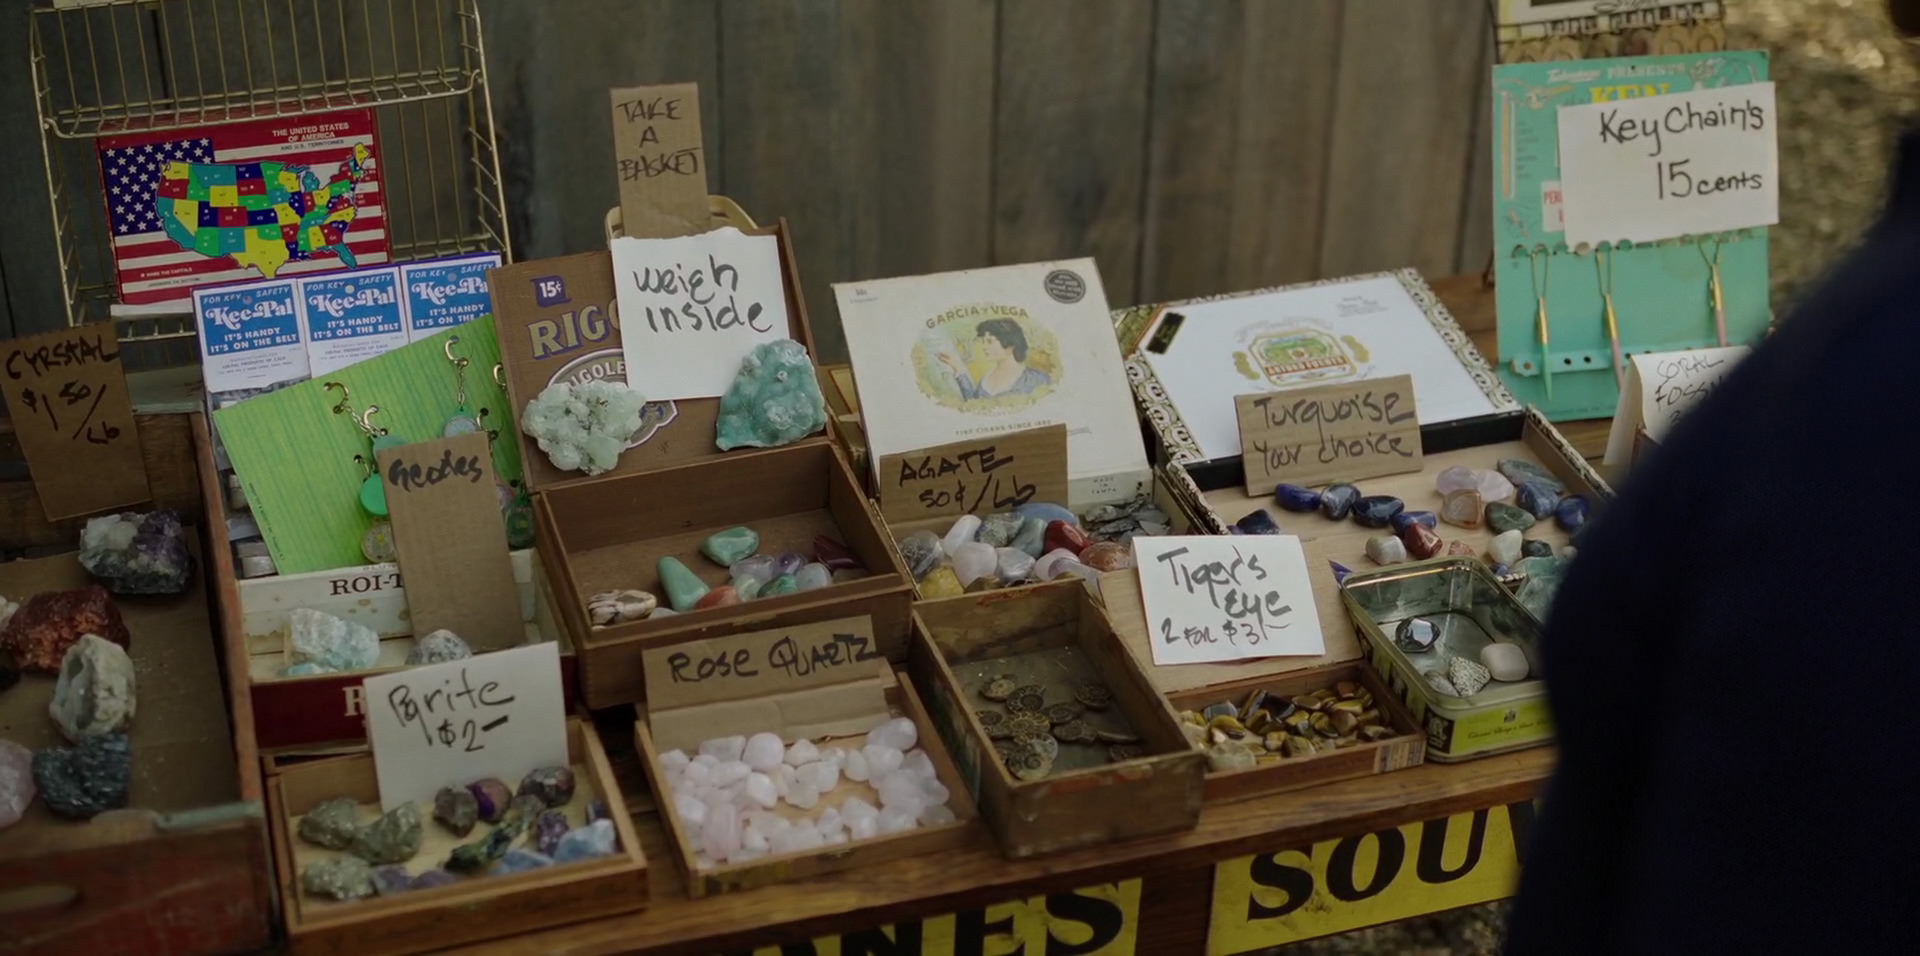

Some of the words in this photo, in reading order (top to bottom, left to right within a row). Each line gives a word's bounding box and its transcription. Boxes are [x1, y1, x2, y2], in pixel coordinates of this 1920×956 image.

[616, 97, 682, 123] TAKE
[272, 128, 288, 137] THE
[289, 125, 318, 136] UNITED
[319, 122, 350, 132] STATES
[288, 135, 300, 143] OF
[301, 132, 336, 142] AMERICA
[639, 126, 660, 148] A
[619, 147, 701, 181] BASKET
[1657, 159, 1693, 201] 15
[1697, 172, 1763, 195] cents
[327, 281, 345, 289] KEY
[359, 274, 392, 285] SAFETY
[410, 271, 426, 279] FOR
[461, 263, 494, 274] SAFETY
[632, 253, 738, 305] weigh
[203, 296, 220, 304] FOR
[224, 293, 242, 302] KEY
[256, 286, 290, 298] SAFETY
[539, 280, 562, 298] 15¢
[327, 319, 345, 328] IT'S
[348, 315, 383, 326] HANDY
[416, 318, 434, 327] IT'S
[438, 316, 453, 324] ON
[429, 308, 447, 316] IT'S
[450, 304, 484, 314] HANDY
[646, 295, 773, 333] inside
[925, 306, 980, 329] GARCIA
[990, 305, 1029, 319] VEGA
[224, 332, 242, 342] IT'S
[245, 327, 280, 339] HANDY
[314, 330, 332, 339] IT'S
[336, 328, 352, 336] ON
[356, 325, 374, 334] THE
[378, 322, 399, 332] BELT
[210, 344, 229, 353] IT'S
[233, 341, 249, 350] ON
[253, 338, 272, 347] THE
[276, 334, 297, 343] BELT
[6, 335, 120, 379] CYRSTAL
[1254, 390, 1415, 447] Turquoise
[1318, 433, 1413, 464] choice
[388, 450, 483, 493] Geodes
[900, 446, 1013, 486] AGATE
[329, 574, 404, 596] ROI-T
[1157, 545, 1267, 609] Tiger's
[1161, 617, 1180, 645] 2
[768, 633, 878, 678] QUARTZ
[1247, 801, 1526, 922] SOU
